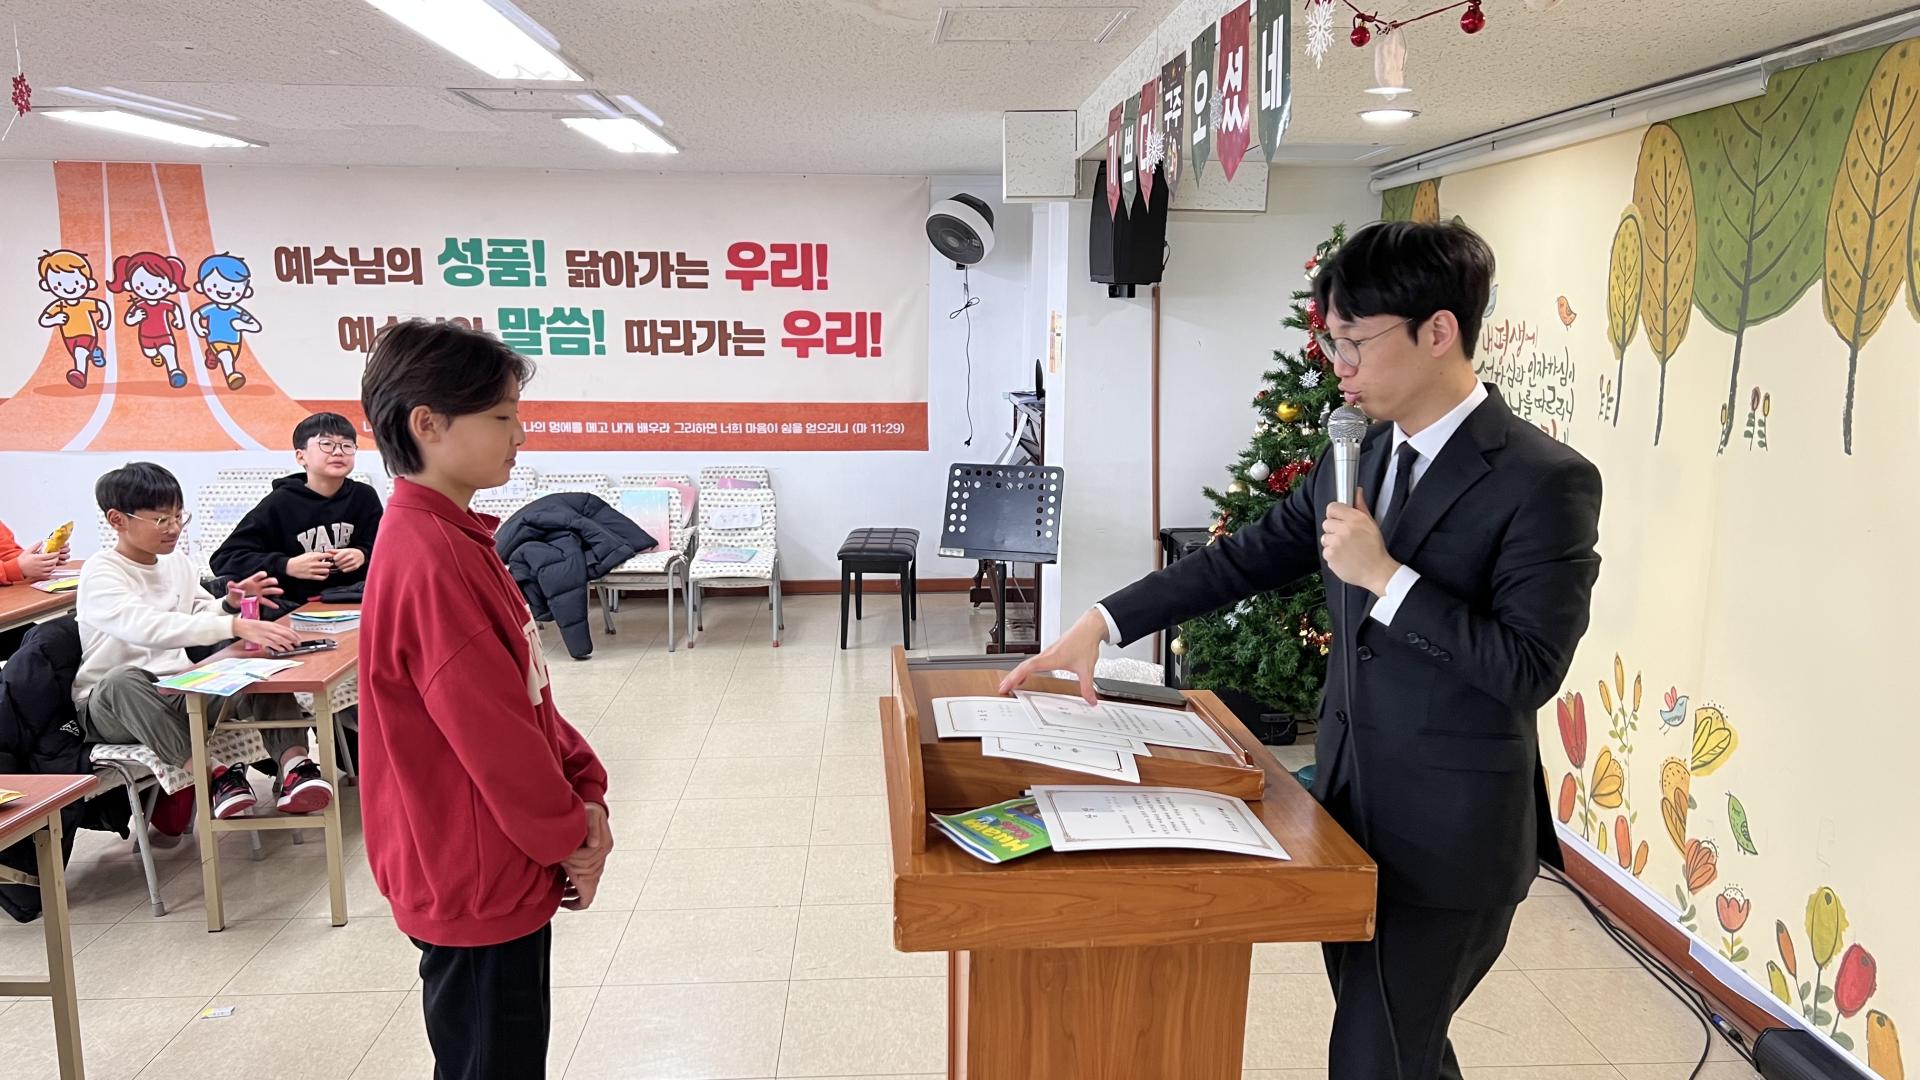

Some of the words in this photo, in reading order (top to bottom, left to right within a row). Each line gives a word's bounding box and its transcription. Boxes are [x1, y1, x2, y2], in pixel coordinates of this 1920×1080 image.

[1164, 85, 1182, 132] 구주
[274, 246, 423, 285] 예수님의
[438, 238, 547, 287] 성품!
[566, 250, 709, 289] 닮아가는
[725, 242, 828, 291] 우리!
[497, 307, 606, 356] 말씀!
[625, 320, 765, 356] 따라가는
[782, 310, 881, 358] 우리!
[523, 420, 546, 433] 나의
[549, 420, 583, 434] 멍에를
[586, 421, 609, 434] 메고
[611, 421, 635, 434] 내게
[637, 421, 671, 434] 배우라
[673, 422, 718, 434] 그리하면
[720, 422, 743, 434] 너희
[745, 422, 778, 434] 마음이
[805, 422, 849, 434] 얻으리니
[852, 422, 868, 435] (마
[870, 422, 905, 435] 11:29)
